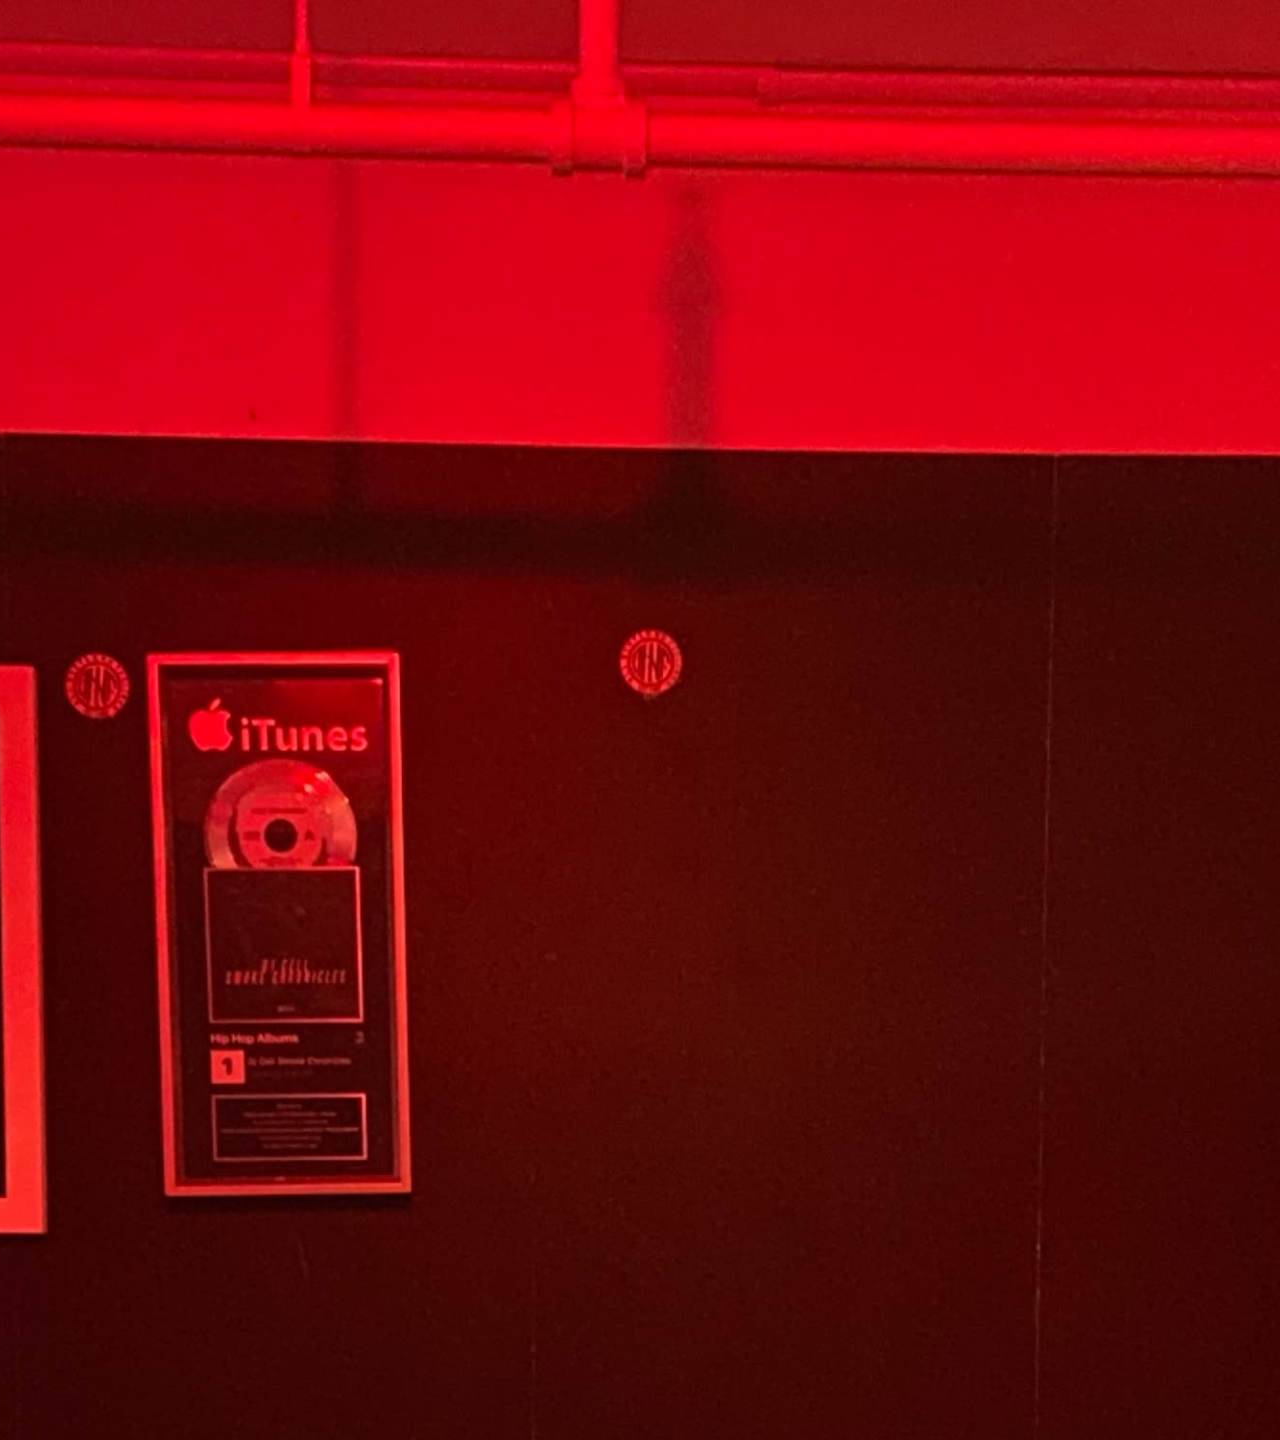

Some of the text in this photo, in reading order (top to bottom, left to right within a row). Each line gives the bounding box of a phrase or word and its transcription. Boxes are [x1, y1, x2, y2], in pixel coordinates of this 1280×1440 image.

[240, 717, 369, 751] iTunes
[210, 1032, 299, 1044] Hip Hop Albums
[221, 1057, 233, 1076] 1
